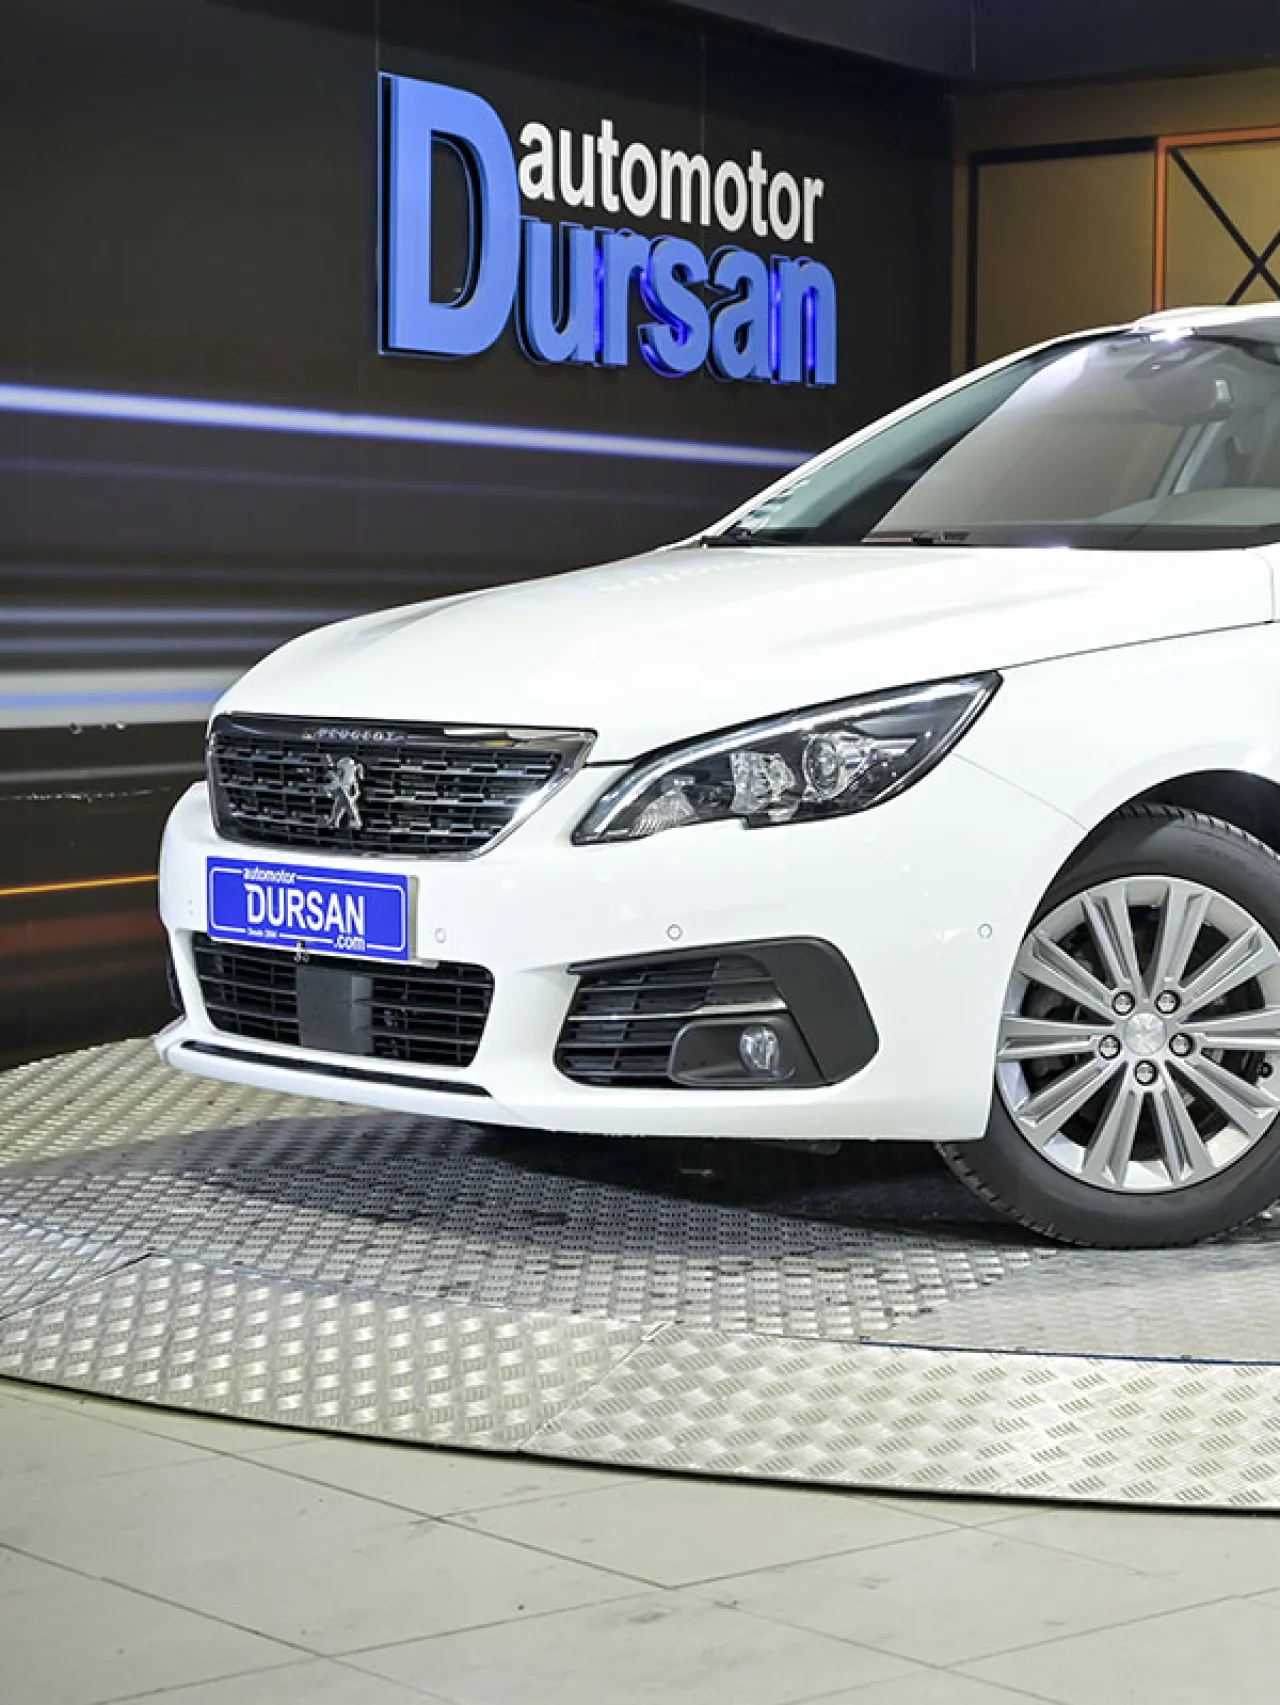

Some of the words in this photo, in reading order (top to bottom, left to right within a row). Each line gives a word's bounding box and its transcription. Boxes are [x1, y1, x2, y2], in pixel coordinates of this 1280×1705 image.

[518, 118, 824, 244] automotor
[379, 70, 838, 388] Dursan
[242, 866, 298, 884] automotor
[244, 883, 366, 936] DURSAN
[332, 933, 367, 951] .com
